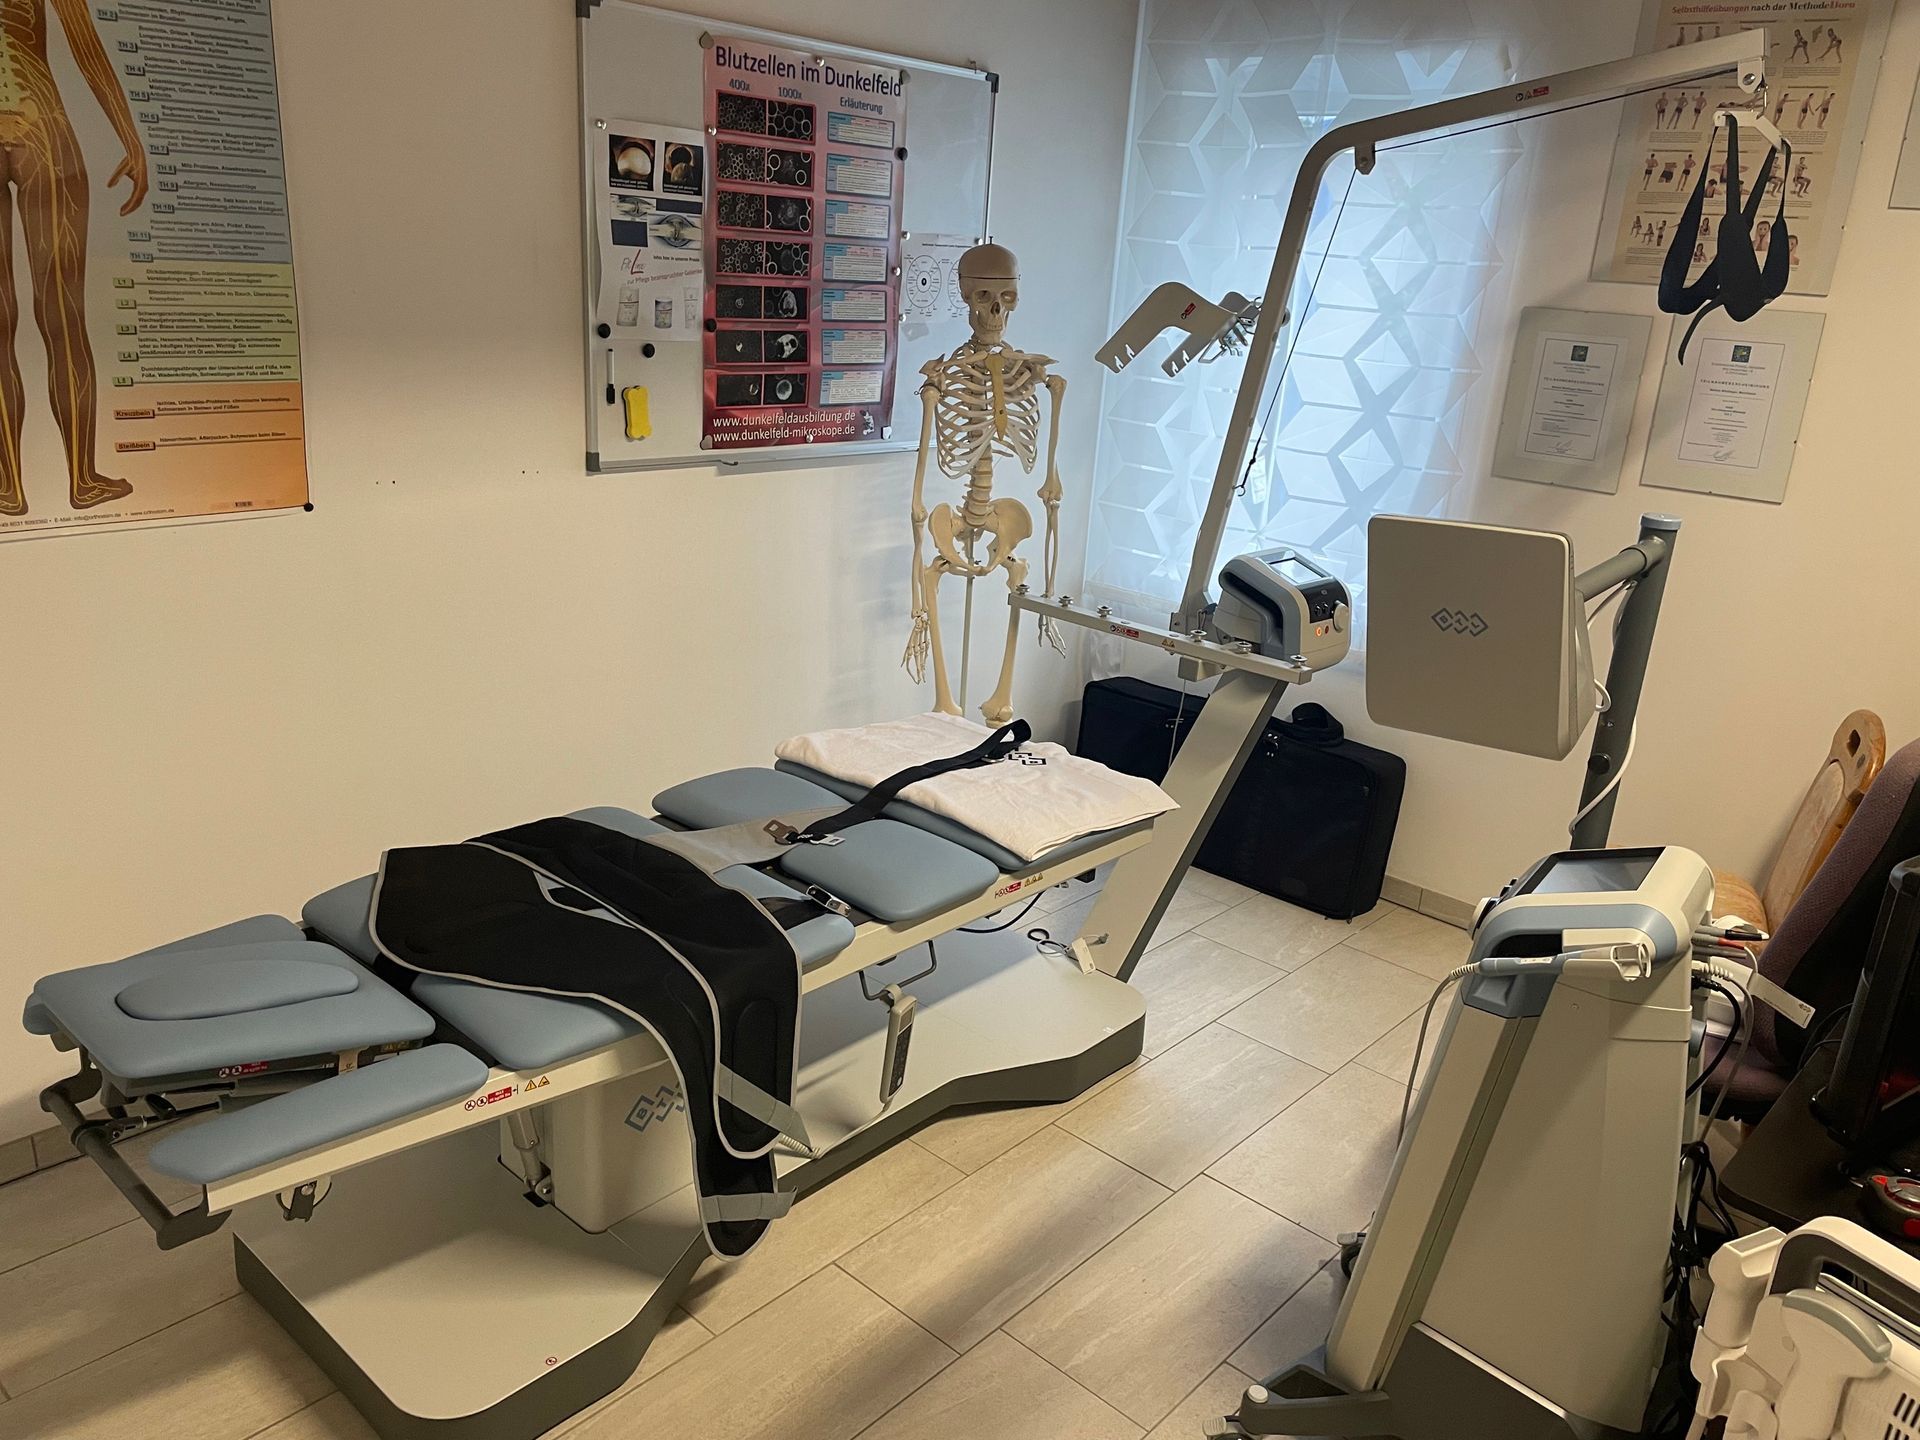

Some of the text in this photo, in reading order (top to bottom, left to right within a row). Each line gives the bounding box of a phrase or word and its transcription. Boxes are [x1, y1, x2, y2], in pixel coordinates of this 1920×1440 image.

[1750, 3, 1770, 11] nach
[1772, 3, 1787, 11] der
[715, 45, 901, 97] Blutzellen im Dunkelfeld
[729, 78, 883, 114] 400x 1000x Erläuterung
[116, 409, 151, 417] Kreuzbein
[712, 410, 856, 427] www.dunkelfeldausbildung.de
[713, 425, 856, 442] www.dunkelfeld-mikroskope.de
